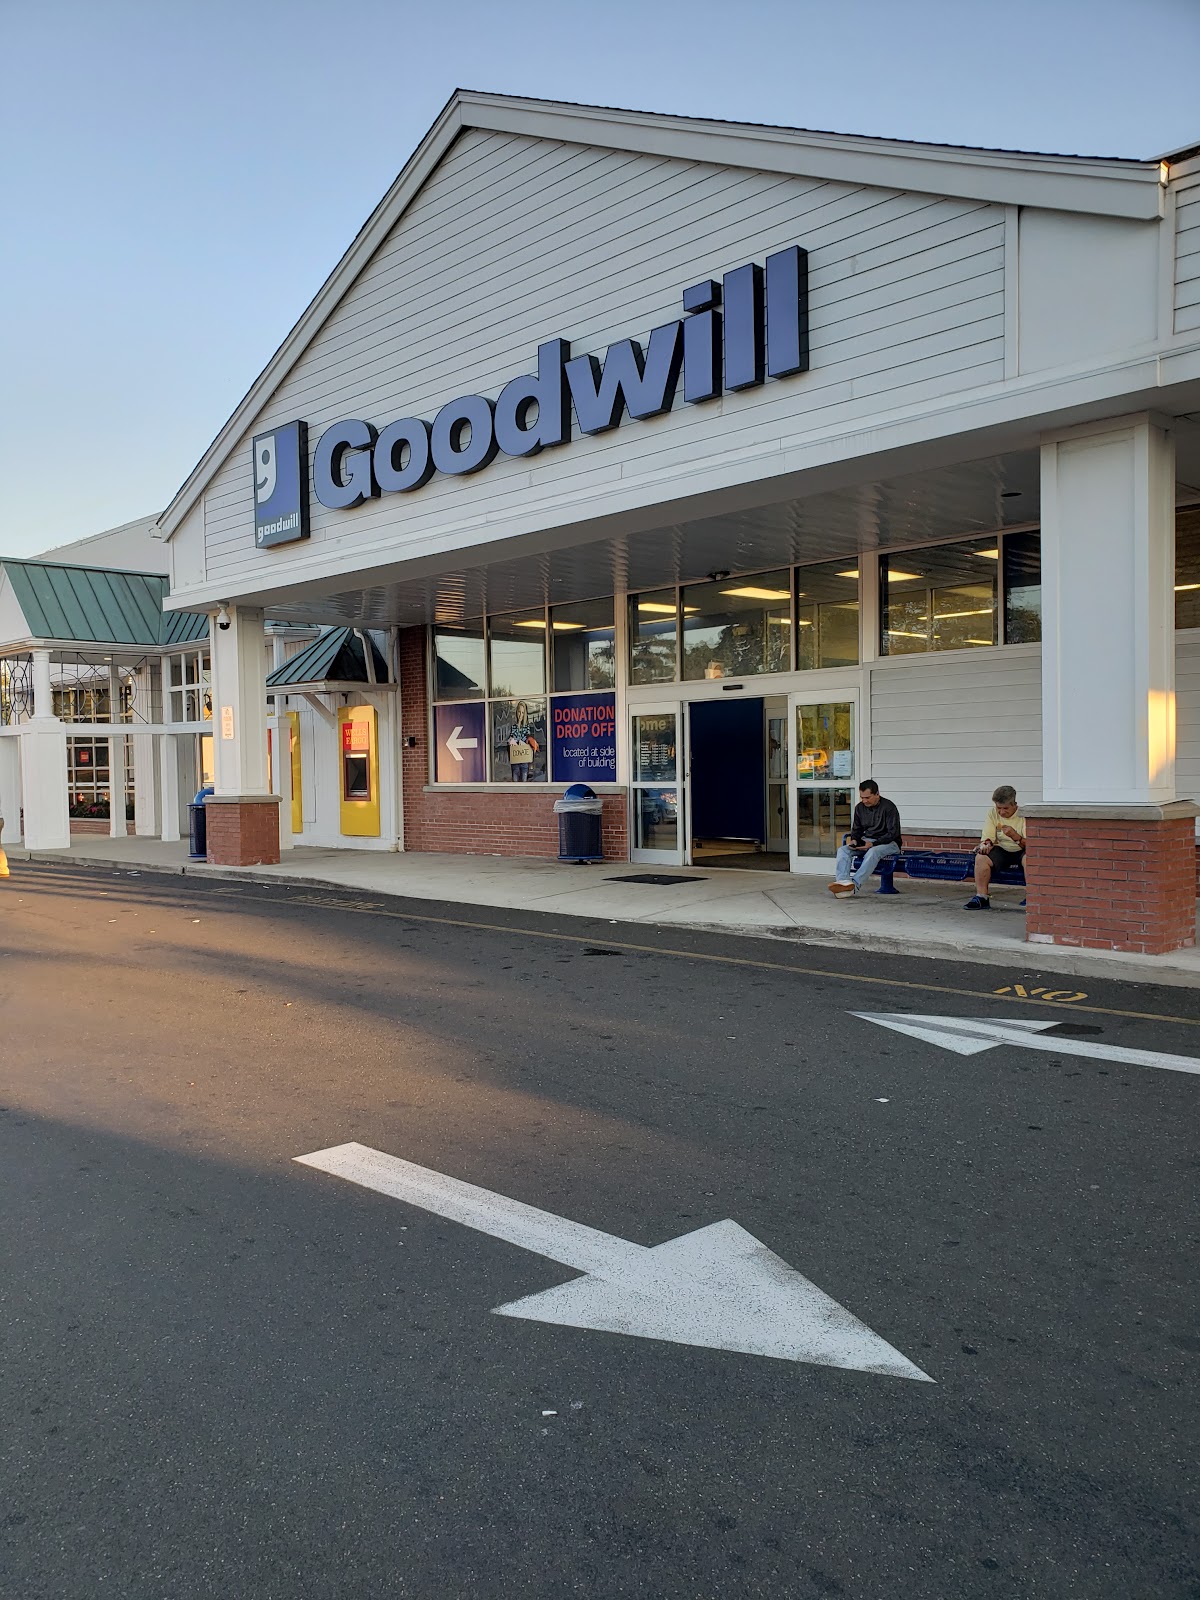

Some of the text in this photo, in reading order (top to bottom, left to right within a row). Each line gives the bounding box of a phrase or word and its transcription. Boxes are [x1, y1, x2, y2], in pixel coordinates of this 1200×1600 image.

[313, 244, 809, 510] Goodwill
[257, 512, 299, 543] goodwill
[554, 706, 614, 722] DONATION
[345, 728, 366, 737] WELLS
[556, 722, 615, 738] DROP OFF
[346, 737, 366, 745] FARGO
[512, 748, 530, 757] DONATE
[563, 745, 615, 757] located at side
[578, 756, 616, 770] of building
[992, 984, 1088, 1002] NO
